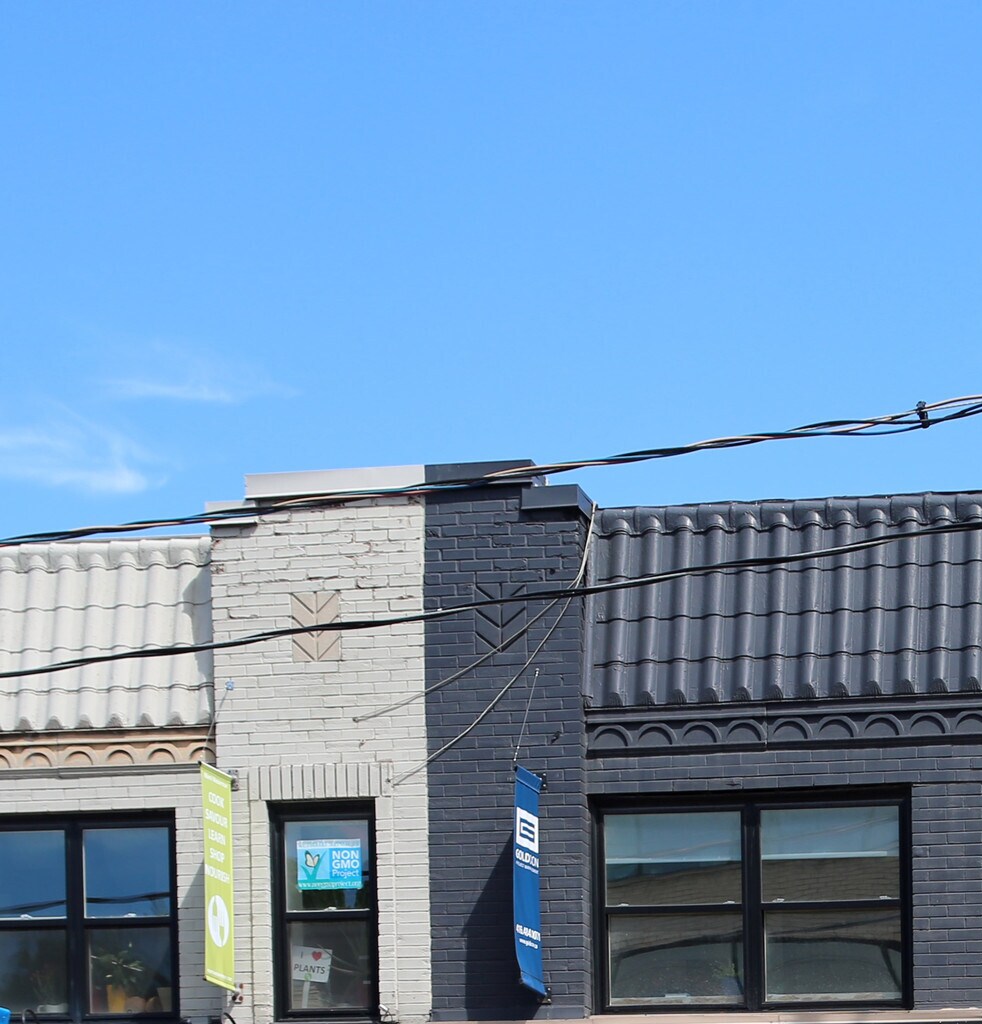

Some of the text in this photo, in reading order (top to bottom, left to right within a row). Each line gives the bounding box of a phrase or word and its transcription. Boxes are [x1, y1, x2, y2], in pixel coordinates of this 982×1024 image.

[209, 847, 225, 863] SHOP
[331, 850, 360, 860] NON
[331, 859, 360, 869] GMO
[332, 869, 360, 879] Project
[294, 963, 326, 975] PLANTS
